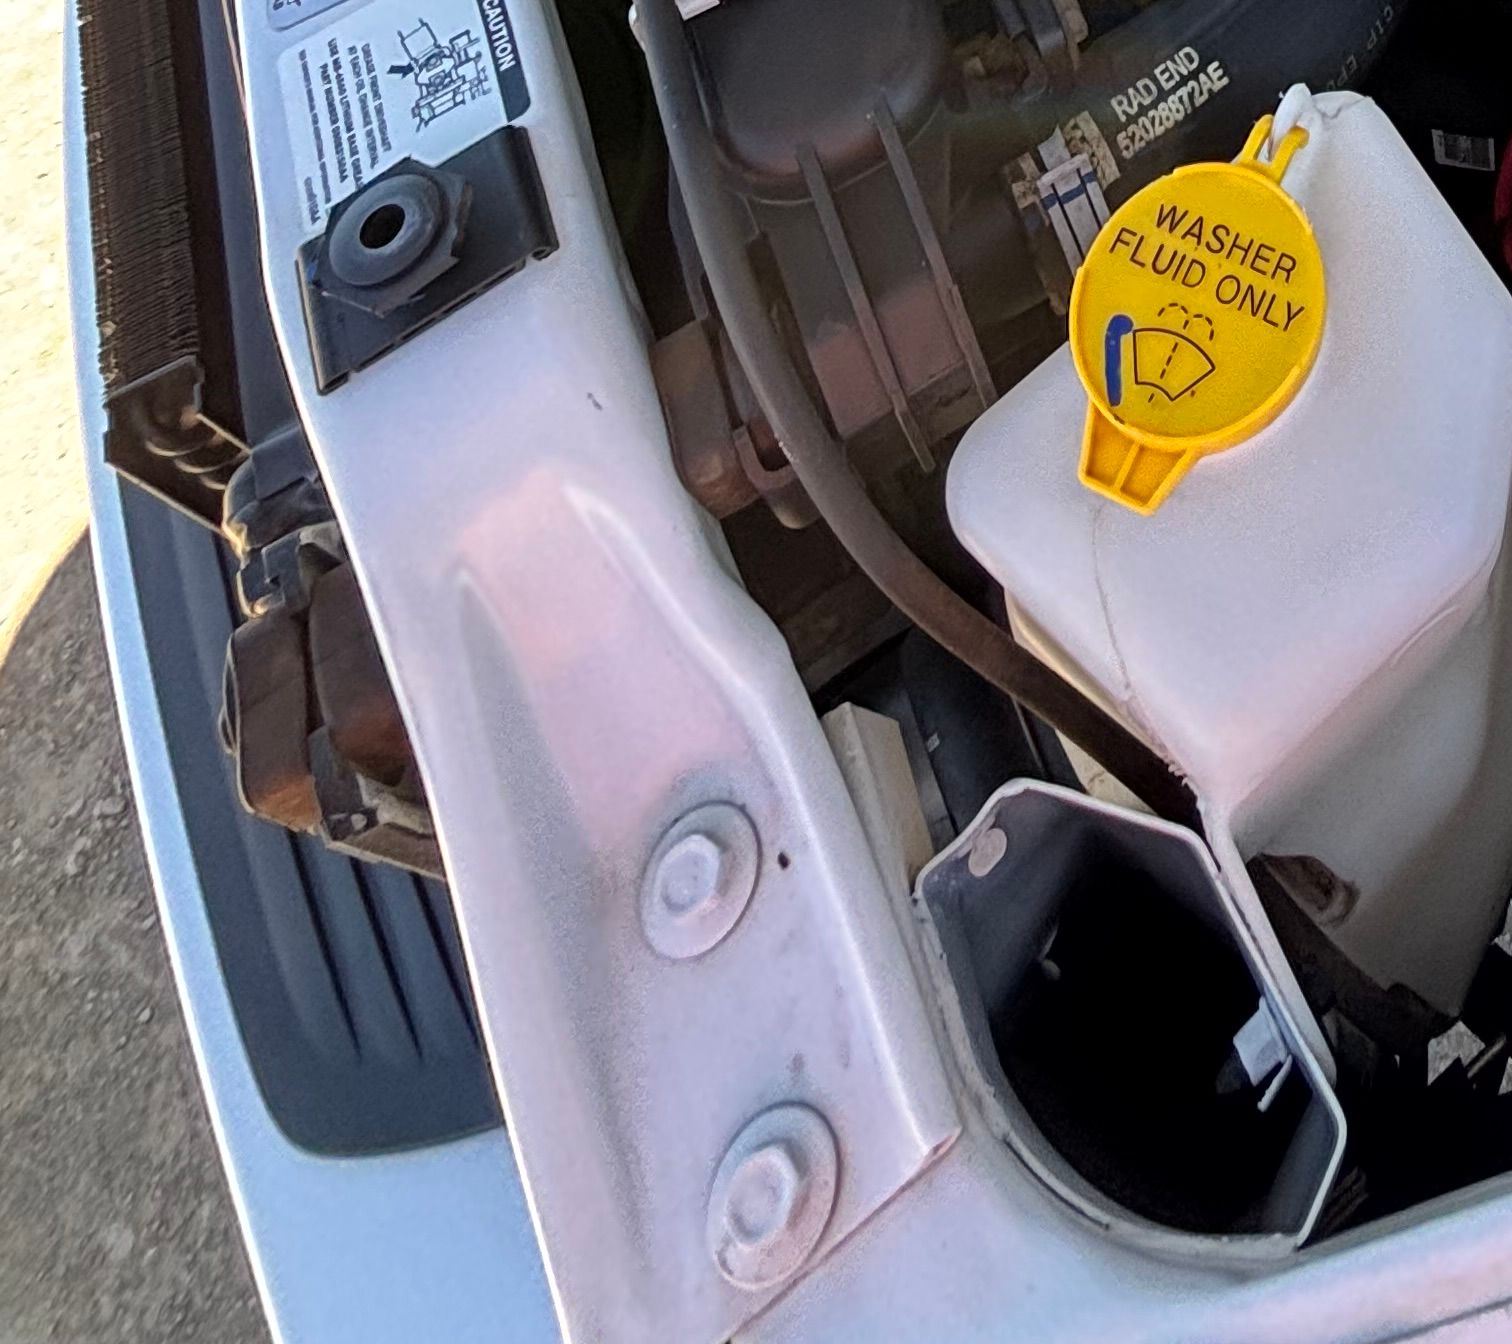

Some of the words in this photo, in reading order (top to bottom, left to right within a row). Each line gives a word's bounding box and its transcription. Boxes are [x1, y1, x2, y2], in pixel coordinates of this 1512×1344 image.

[346, 44, 357, 56] AT
[348, 55, 363, 80] EACH
[318, 62, 332, 87] PART
[354, 77, 366, 94] OIL
[366, 73, 383, 103] FRONT
[1110, 78, 1158, 122] RAD
[1154, 46, 1200, 91] END
[321, 86, 340, 126] NUMBER
[327, 37, 340, 57] USE
[348, 156, 368, 190] GREAS
[355, 92, 374, 128] CHANGE
[1116, 61, 1230, 159] 52028872AE
[361, 126, 383, 169] INTERVAL
[370, 101, 394, 153] DRIVESHAFT
[1155, 203, 1297, 284] WASHER
[1108, 226, 1206, 289] FLUID
[1215, 274, 1305, 332] ONLY
